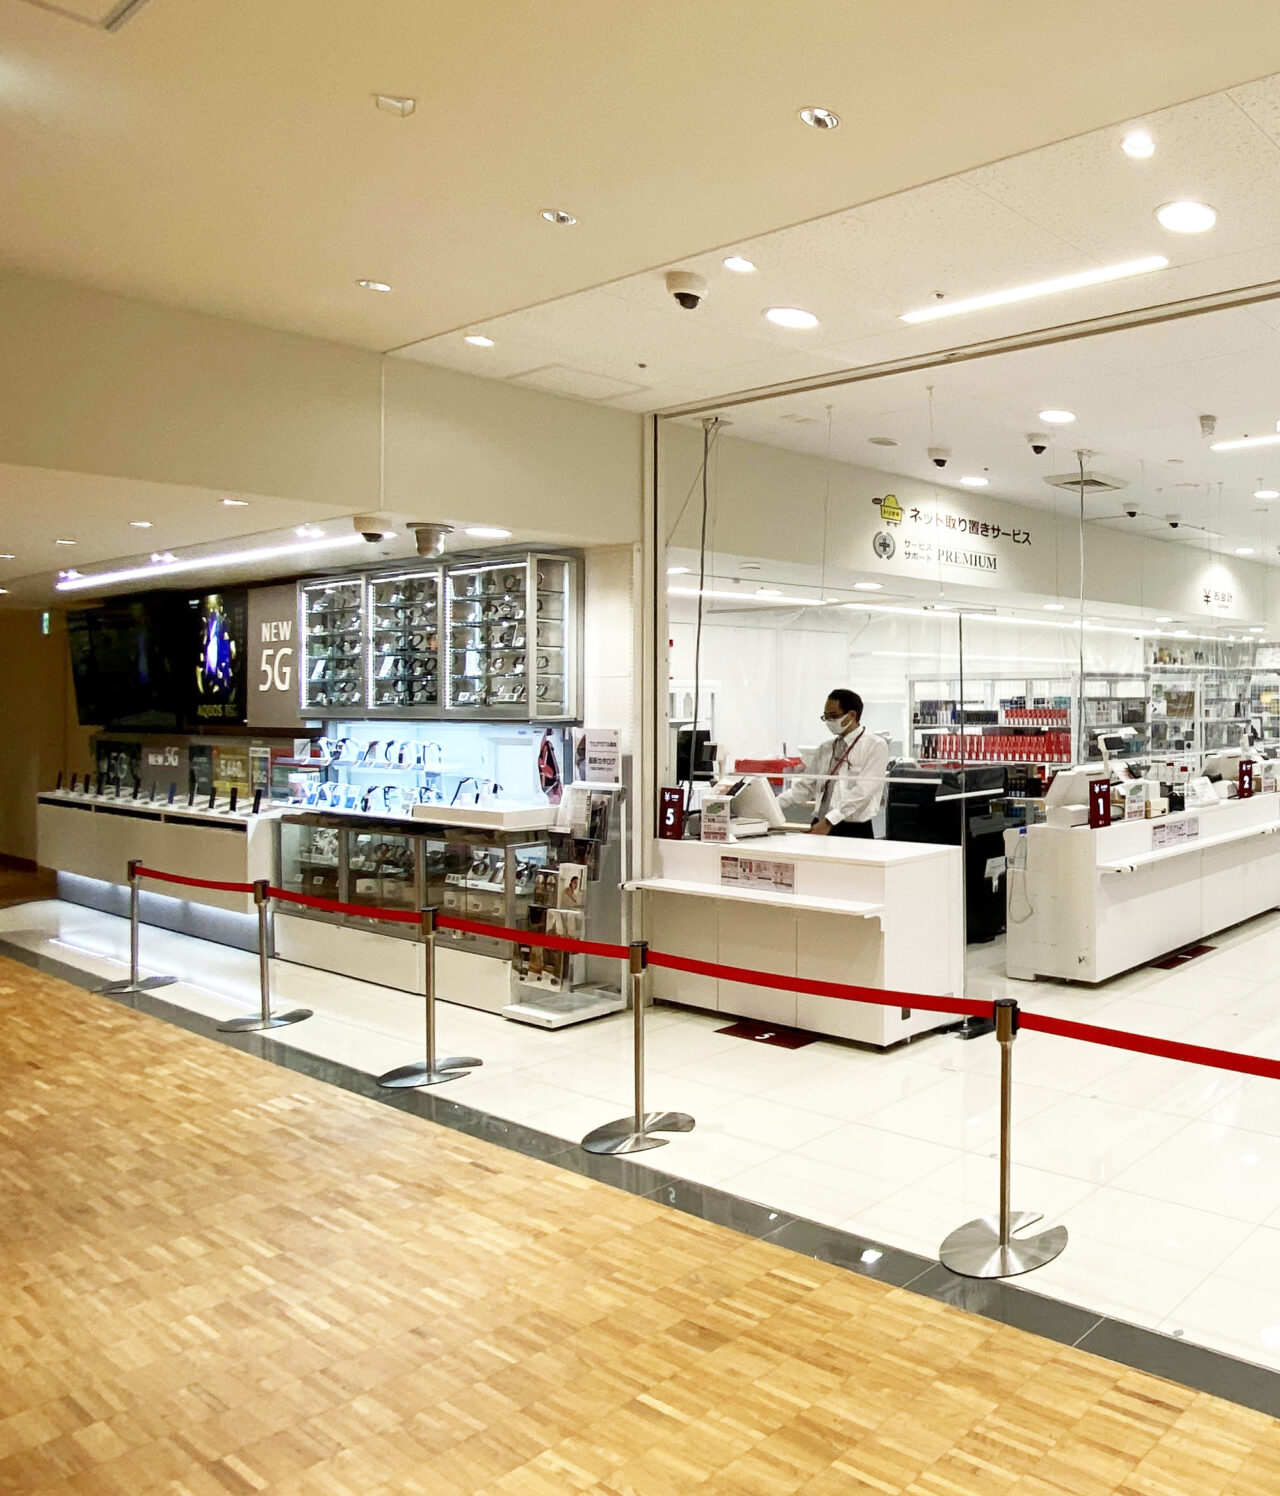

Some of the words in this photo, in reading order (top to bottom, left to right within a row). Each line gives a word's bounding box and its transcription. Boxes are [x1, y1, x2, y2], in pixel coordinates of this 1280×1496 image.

[909, 507, 1032, 546] ネット取り置きサービス
[937, 548, 998, 570] PREMIUM
[261, 620, 292, 642] NEW
[259, 647, 293, 692] 5G
[665, 808, 675, 826] 5
[1097, 797, 1105, 815] 1
